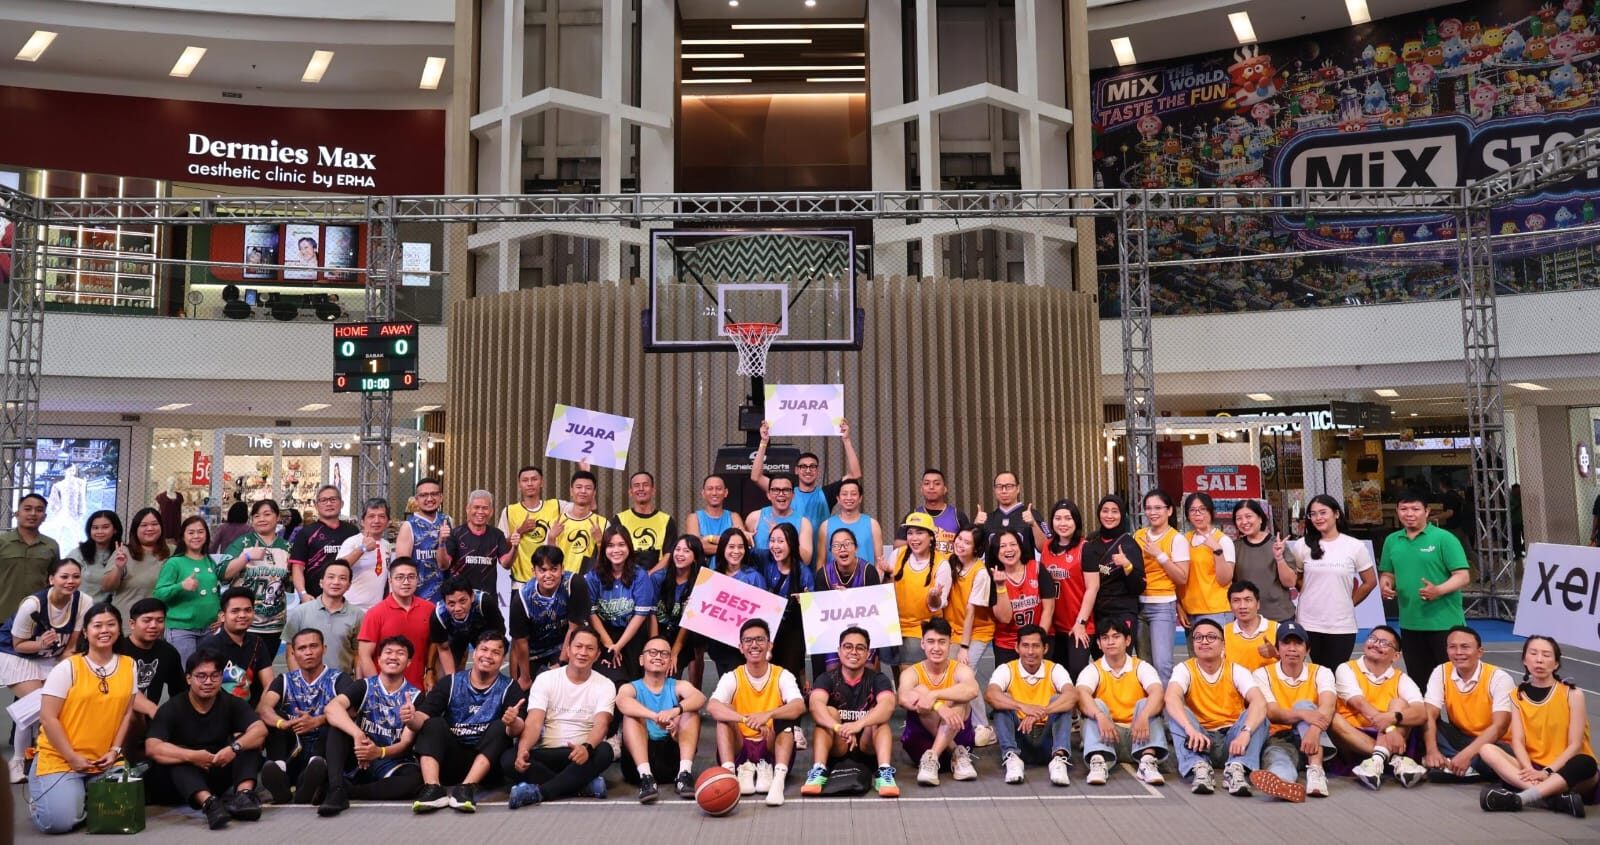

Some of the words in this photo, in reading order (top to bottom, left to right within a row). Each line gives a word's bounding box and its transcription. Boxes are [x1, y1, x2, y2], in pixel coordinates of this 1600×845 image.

[1168, 65, 1194, 81] THE
[1107, 75, 1159, 102] MiX
[1098, 100, 1153, 127] TASTE
[1157, 93, 1186, 110] THE
[1190, 82, 1227, 105] FUN
[188, 133, 309, 165] Dermies
[316, 146, 377, 170] Max
[188, 160, 262, 181] aesthetic
[265, 166, 306, 184] clinic
[312, 171, 333, 188] by
[336, 174, 376, 188] ERHA
[1305, 145, 1442, 201] MiX
[335, 326, 369, 337] HOME
[380, 325, 413, 335] AWAY
[341, 341, 355, 357] 0
[394, 339, 408, 355] 0
[368, 359, 377, 374] 1
[337, 376, 345, 387] 0
[362, 378, 390, 390] 10:00
[404, 374, 412, 385] 0
[778, 399, 829, 411] JUARA
[801, 413, 809, 426] 1
[565, 422, 616, 441] JUARA
[247, 436, 273, 448] The
[581, 440, 594, 454] 2
[1196, 474, 1248, 491] SALE
[416, 549, 438, 560] UTILIT
[716, 590, 761, 614] BEST
[700, 601, 748, 628] YEL-Y
[820, 604, 880, 622] JUARA
[1014, 610, 1034, 626] 97
